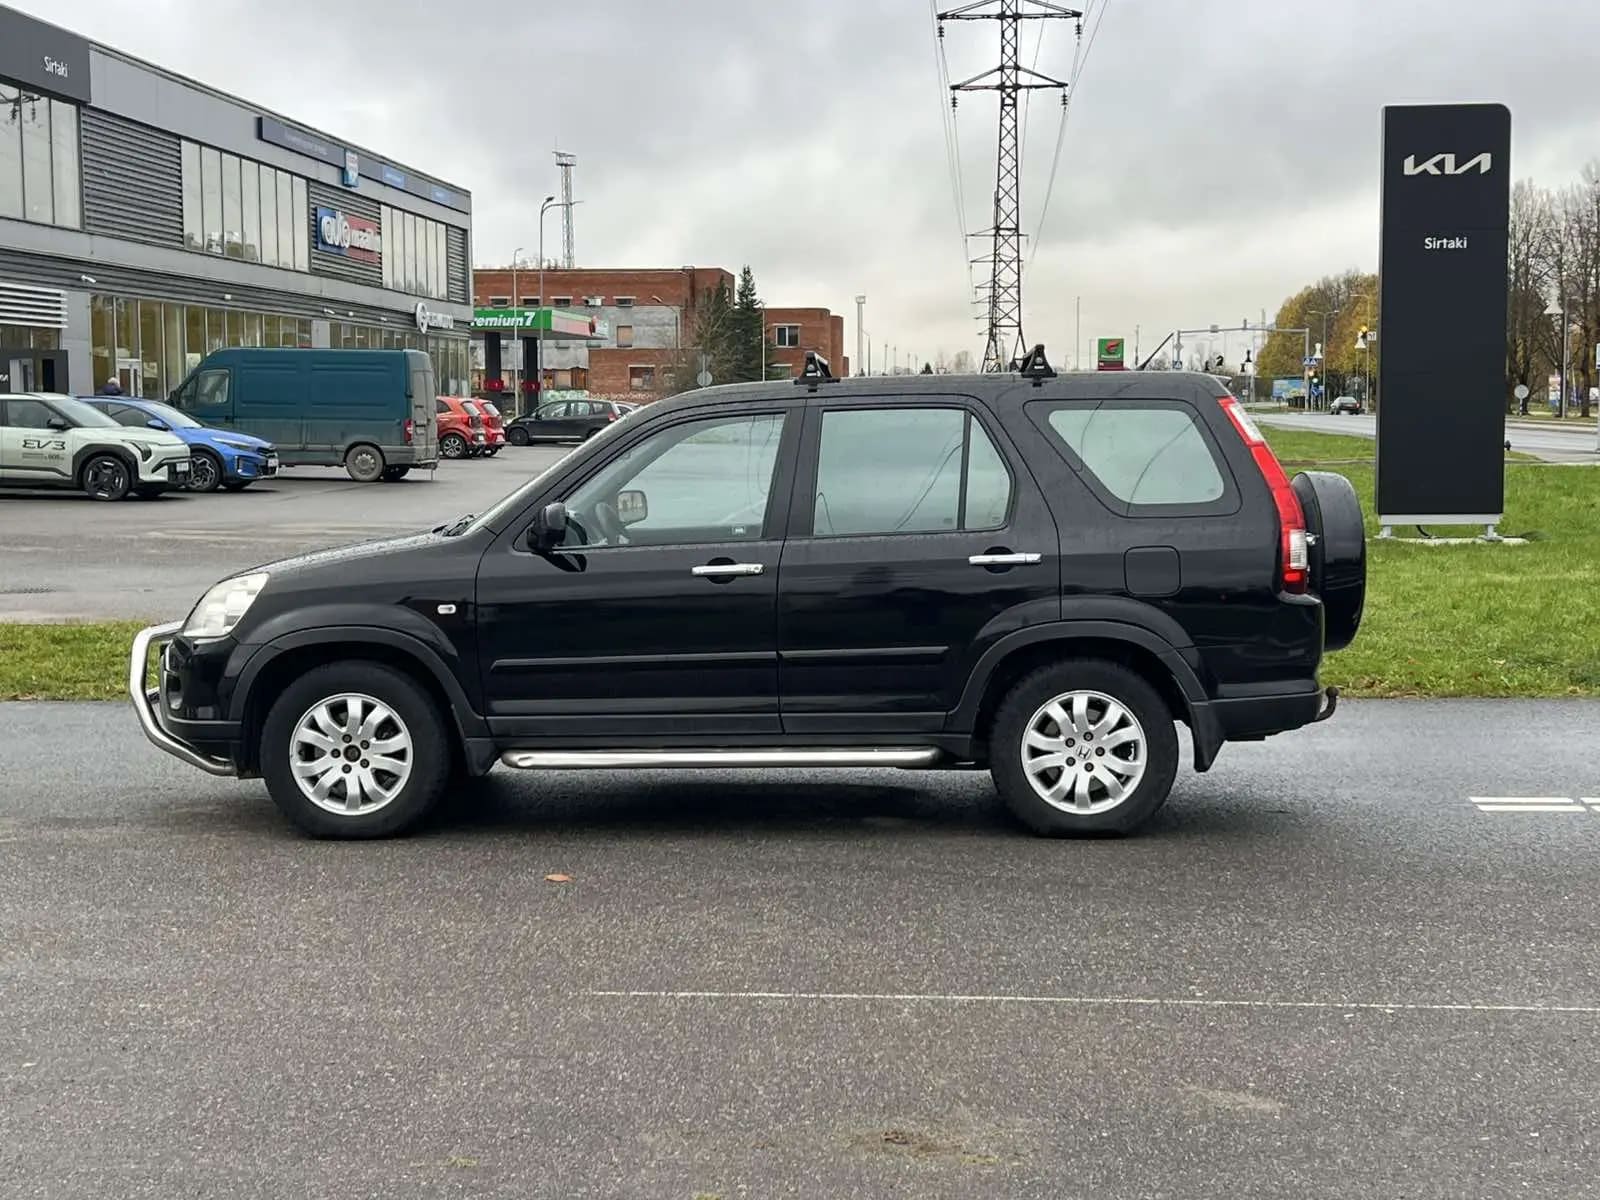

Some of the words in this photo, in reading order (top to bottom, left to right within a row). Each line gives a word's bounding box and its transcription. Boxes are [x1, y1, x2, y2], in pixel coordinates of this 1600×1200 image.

[44, 56, 68, 78] Sirtaki
[1403, 153, 1492, 176] KIA
[1424, 237, 1468, 249] Sirtaki
[22, 439, 66, 450] EV3
